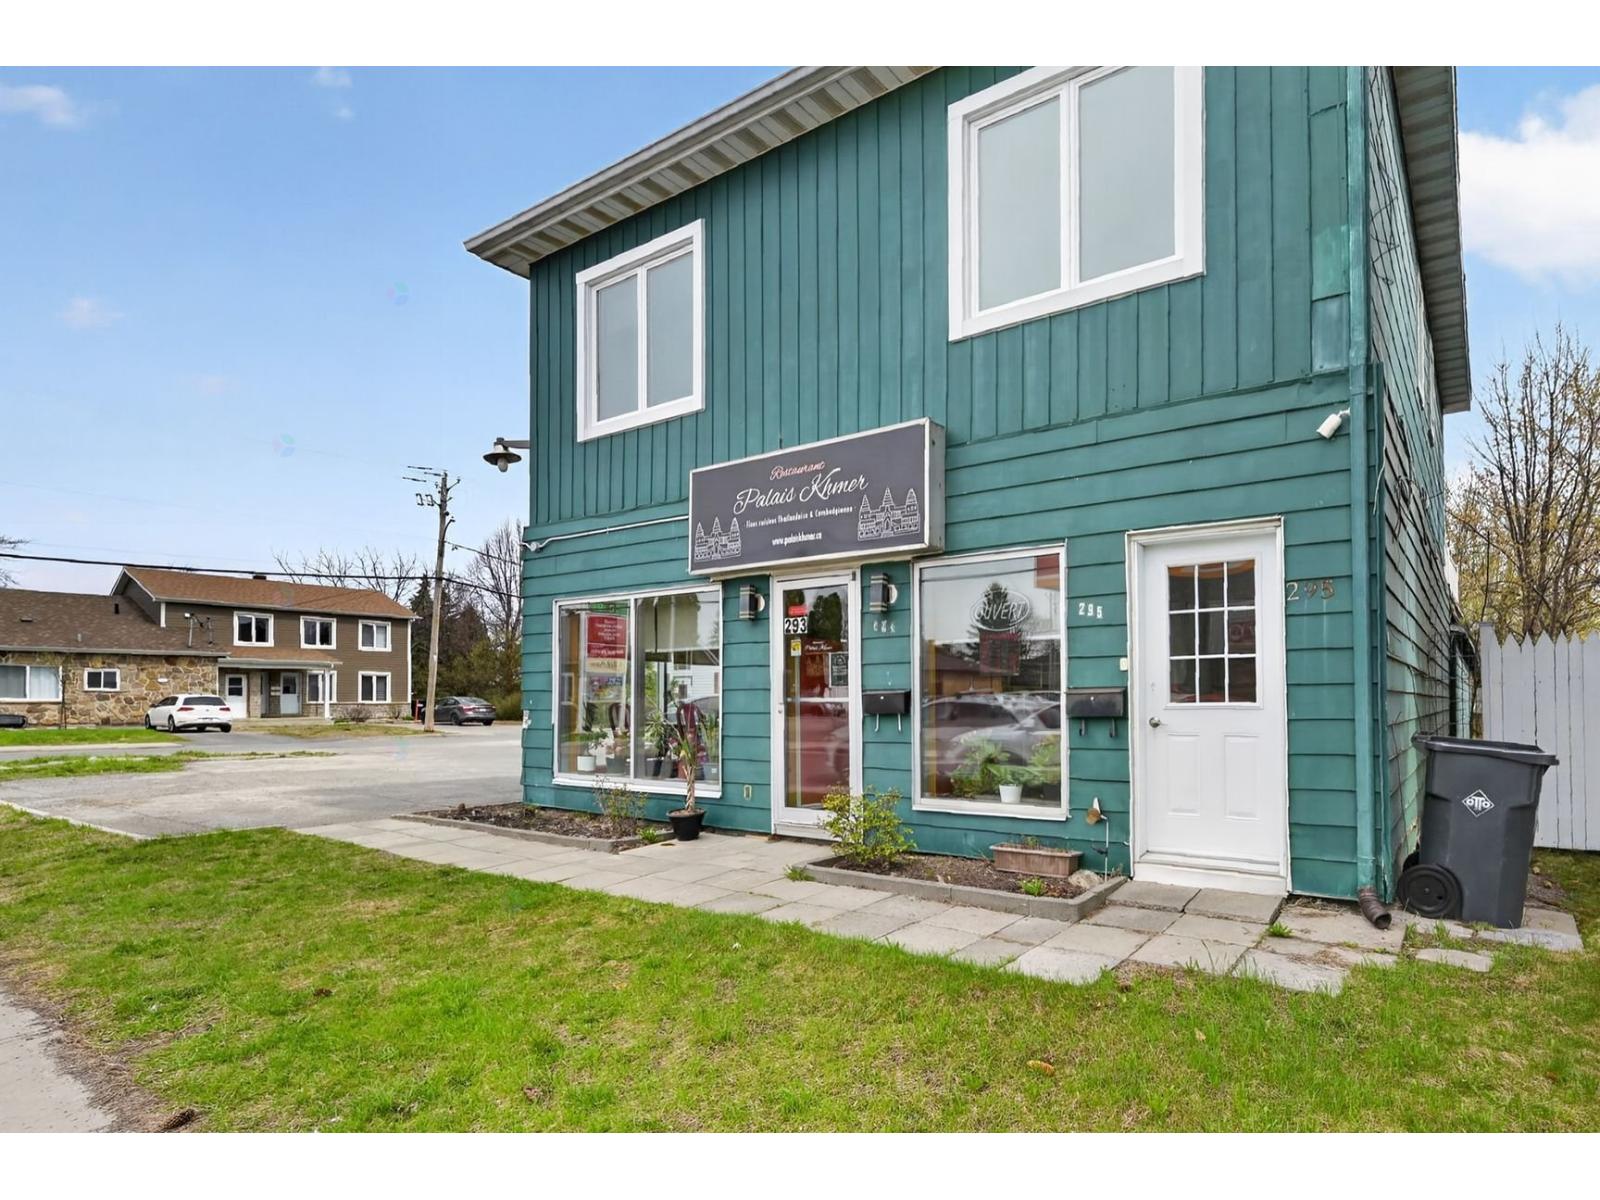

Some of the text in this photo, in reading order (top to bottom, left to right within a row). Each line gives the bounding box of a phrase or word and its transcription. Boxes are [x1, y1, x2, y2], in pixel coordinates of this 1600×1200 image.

[770, 460, 826, 481] Restaurant
[733, 467, 869, 515] Palais Khmer
[809, 510, 814, 518] &
[1286, 579, 1335, 601] 295
[975, 602, 1026, 620] OUVERT
[1078, 602, 1104, 619] 295
[785, 618, 808, 633] 293
[1466, 795, 1491, 811] OTTO
